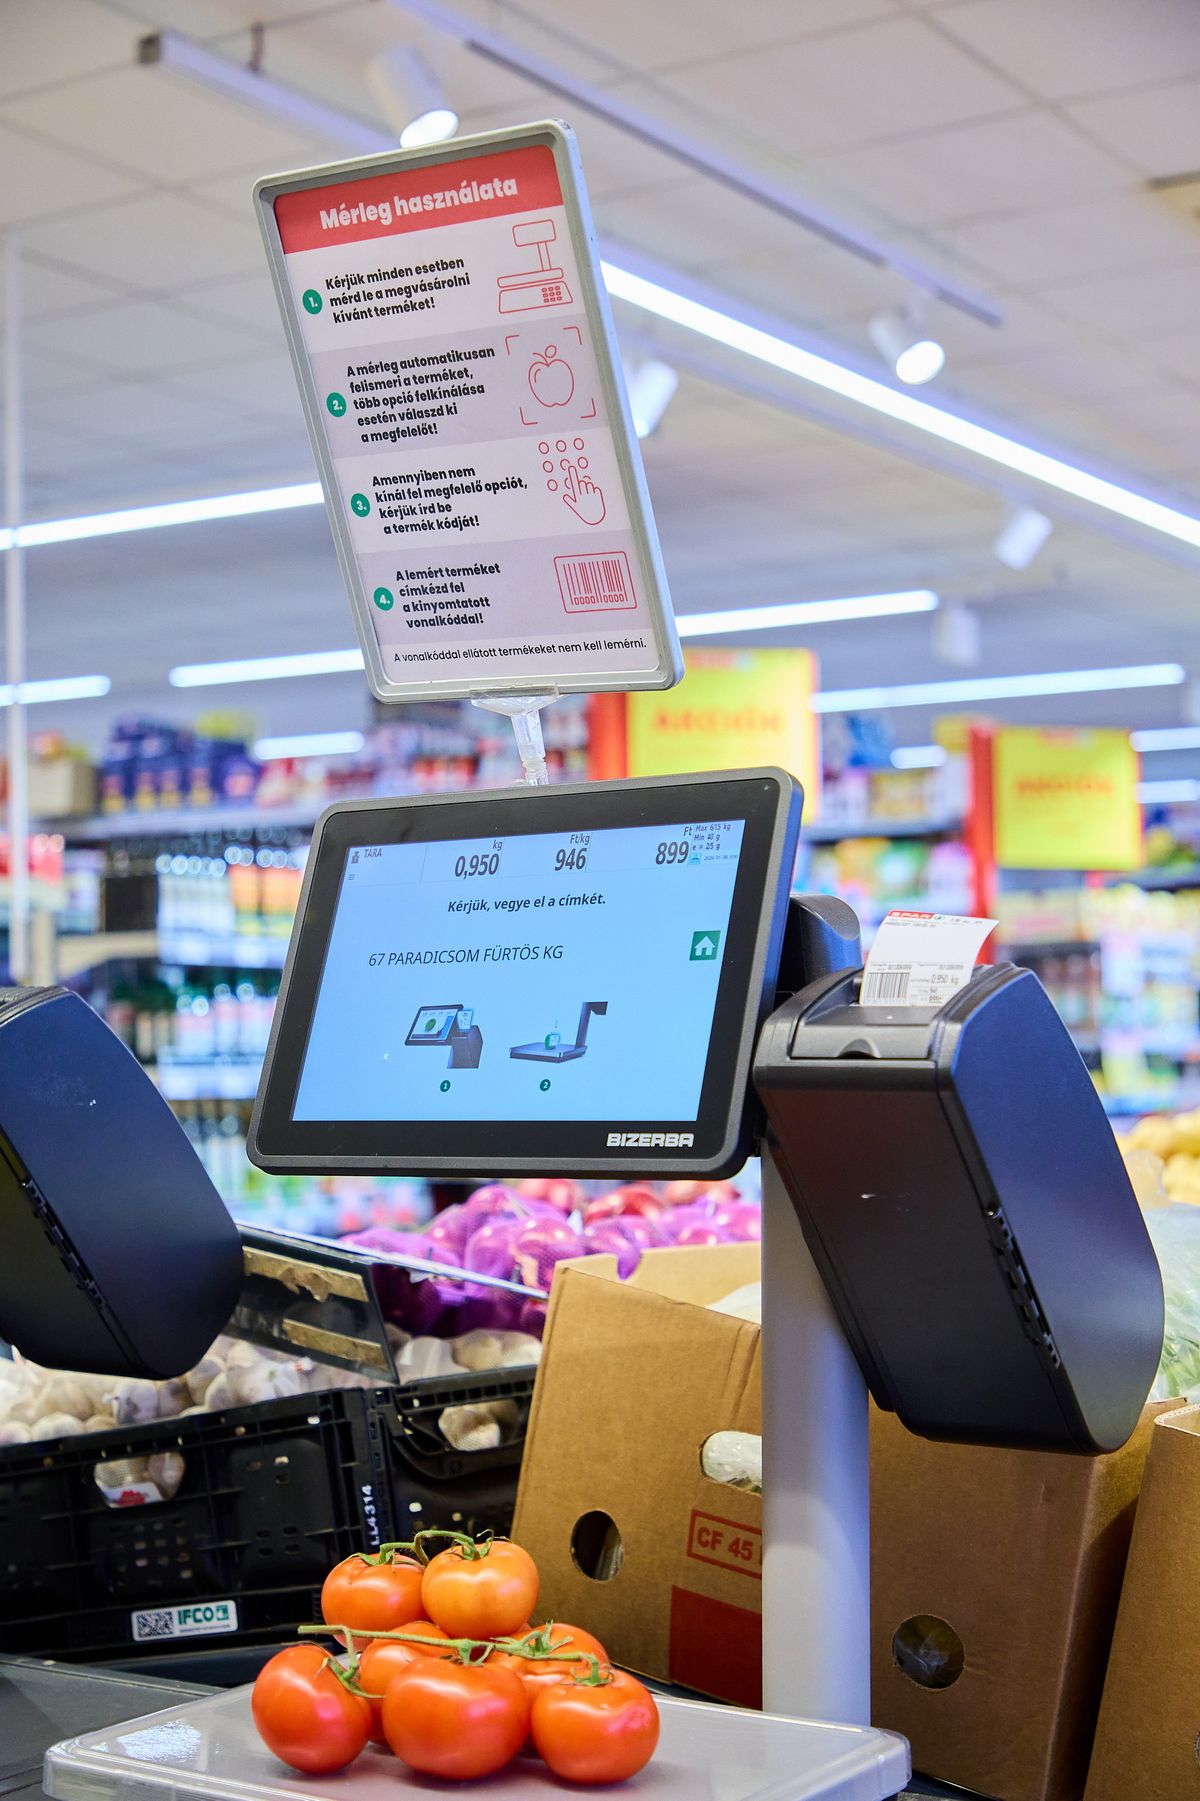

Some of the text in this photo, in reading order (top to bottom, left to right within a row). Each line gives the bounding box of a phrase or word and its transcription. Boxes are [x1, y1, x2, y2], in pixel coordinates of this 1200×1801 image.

[320, 178, 518, 229] Mérleg használata
[326, 259, 464, 290] Kérjük minden esetben
[330, 272, 470, 306] mérd le a megvásárolni
[309, 297, 318, 307] 1.
[333, 297, 435, 323] kívánt terméket!
[348, 348, 495, 377] A mérleg automatikusan
[350, 368, 472, 393] felismeri a terméket,
[333, 400, 342, 410] 2.
[354, 383, 484, 409] több opció felkínálása
[358, 402, 457, 426] esetén válaszd ki
[361, 423, 438, 442] a megfelelőt!
[373, 468, 475, 486] Amennyiben nem
[375, 477, 527, 502] kínál fel megfelelő opciót,
[357, 501, 366, 510] 3.
[379, 503, 452, 519] kérjük írd be
[393, 519, 435, 533] termék
[437, 515, 479, 531] kódját!
[397, 563, 500, 581] A lemért terméket
[400, 582, 464, 596] címkézd fel
[380, 595, 390, 604] 4.
[412, 597, 490, 612] kinyomtatott
[406, 613, 483, 628] vonalkóddal!
[402, 650, 460, 661] vonalkóddal
[463, 648, 497, 658] ellátott
[498, 645, 556, 656] termékeket
[584, 641, 602, 650] kell
[604, 638, 646, 649] lemérni.
[570, 831, 590, 845] Ft/kg
[684, 826, 692, 836] Ft
[493, 840, 502, 851] kg
[656, 841, 689, 864] 899
[455, 854, 499, 879] 0,950
[555, 848, 587, 871] 946
[448, 893, 605, 914] Kérjük, vegye el a címkét.
[369, 944, 563, 966] 67 PARADICSOM FÜRTÖS KG
[607, 1133, 694, 1147] BIZERBA
[697, 1526, 723, 1551] CF
[728, 1536, 754, 1561] 45
[177, 1606, 214, 1625] IFCO
